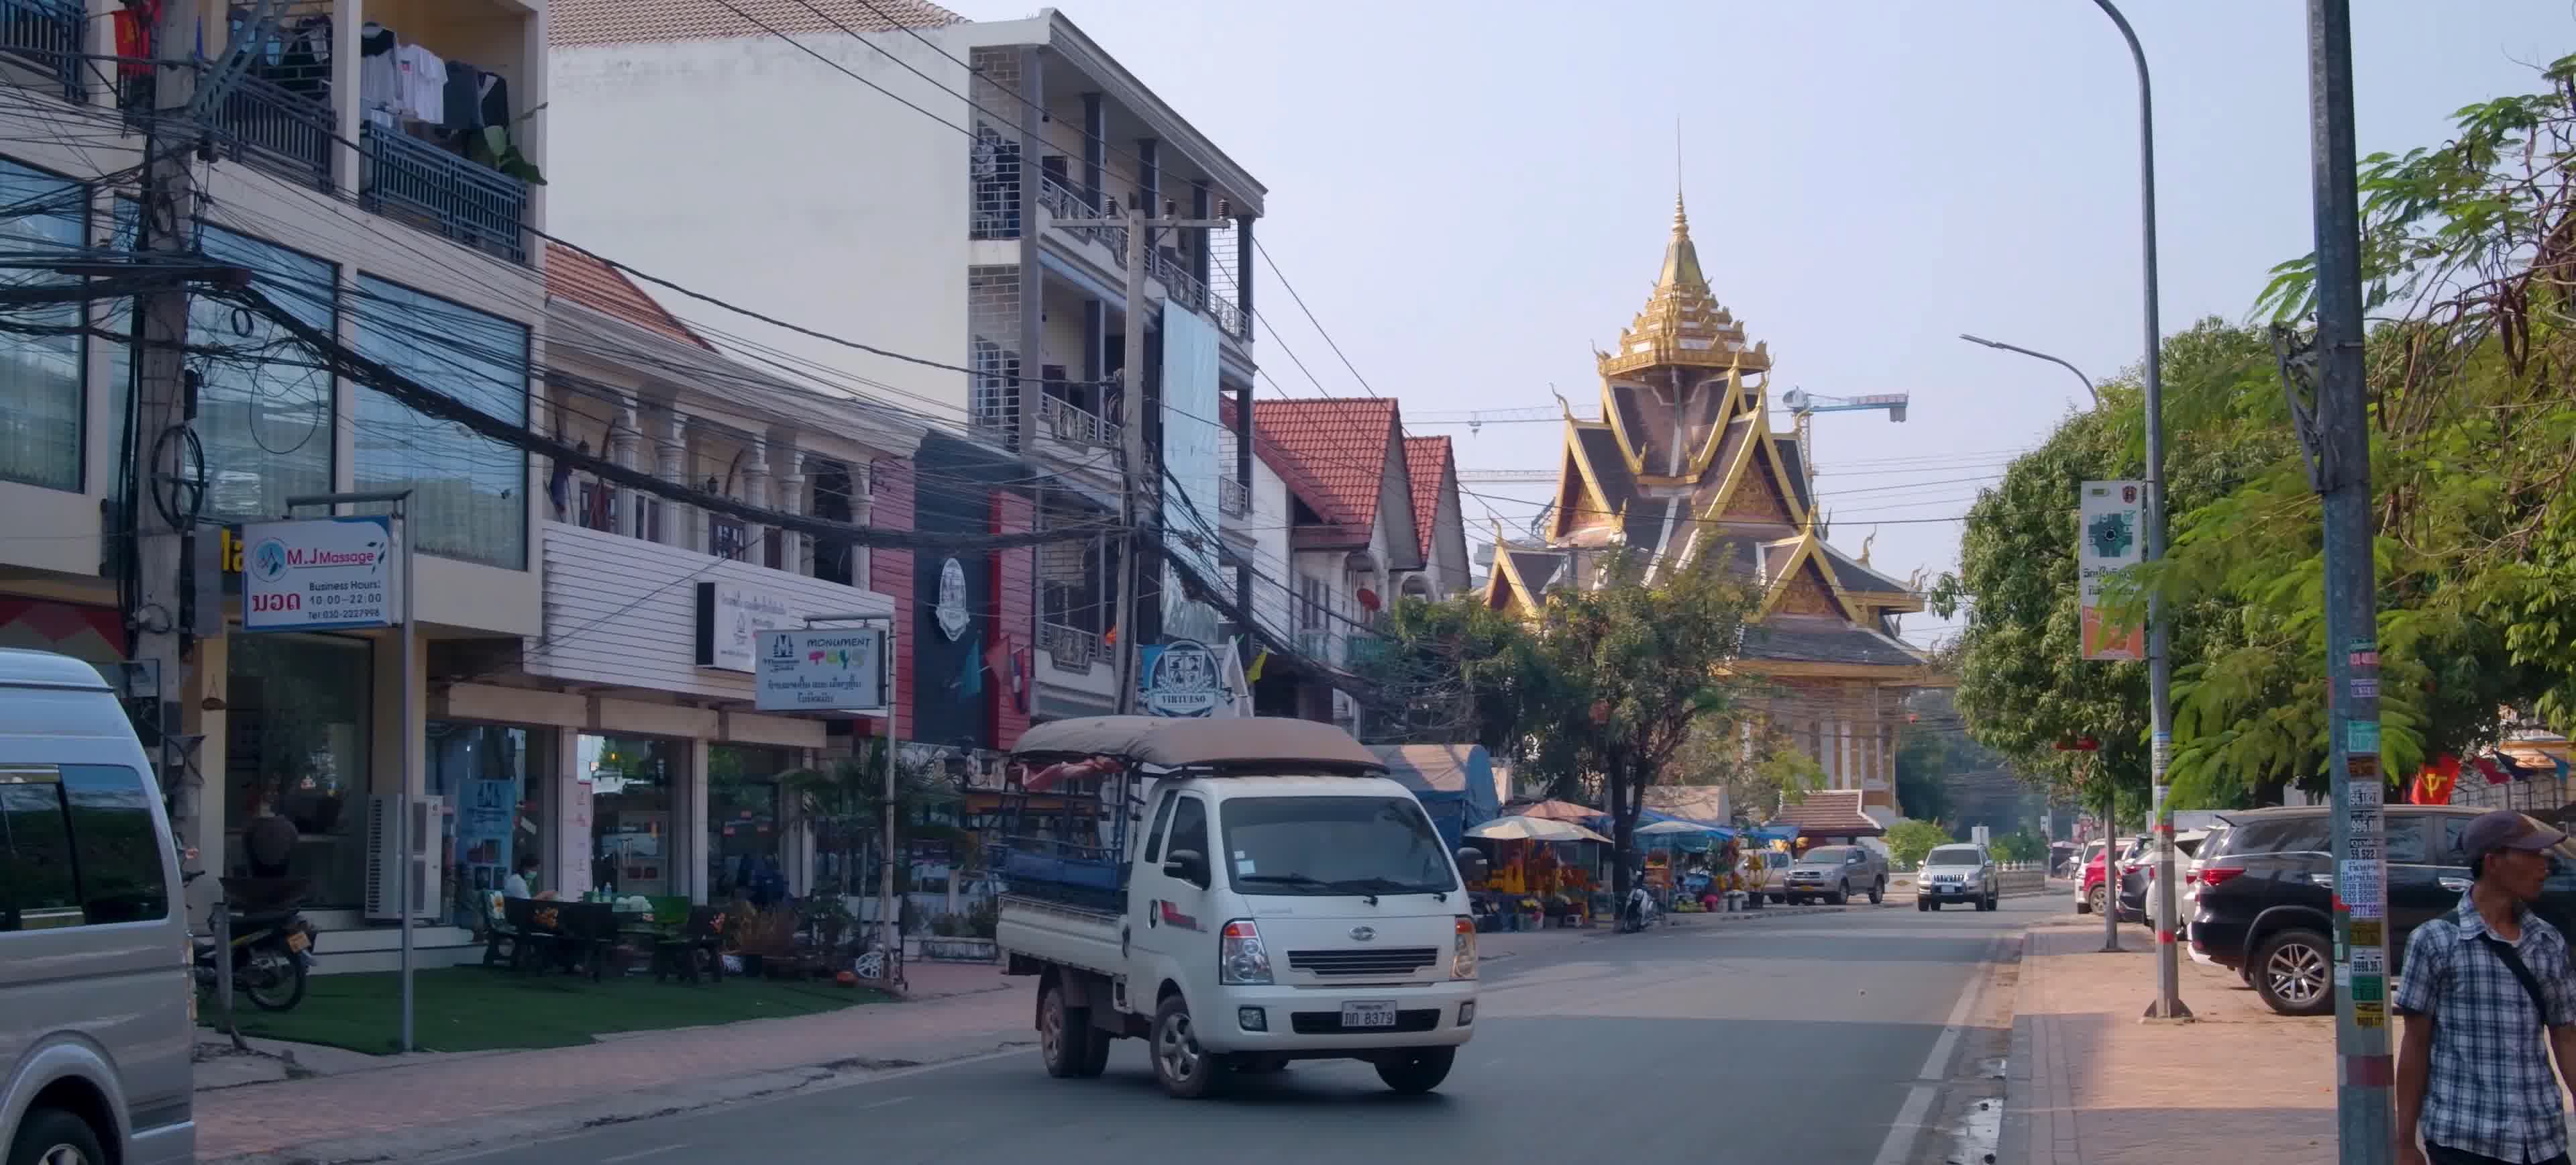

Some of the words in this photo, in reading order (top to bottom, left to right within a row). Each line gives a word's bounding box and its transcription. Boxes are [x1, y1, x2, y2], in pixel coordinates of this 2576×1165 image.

[309, 582, 348, 591] Business
[350, 580, 381, 590] Hours:
[807, 638, 871, 649] MONUMENT
[1364, 1011, 1393, 1025] 8379
